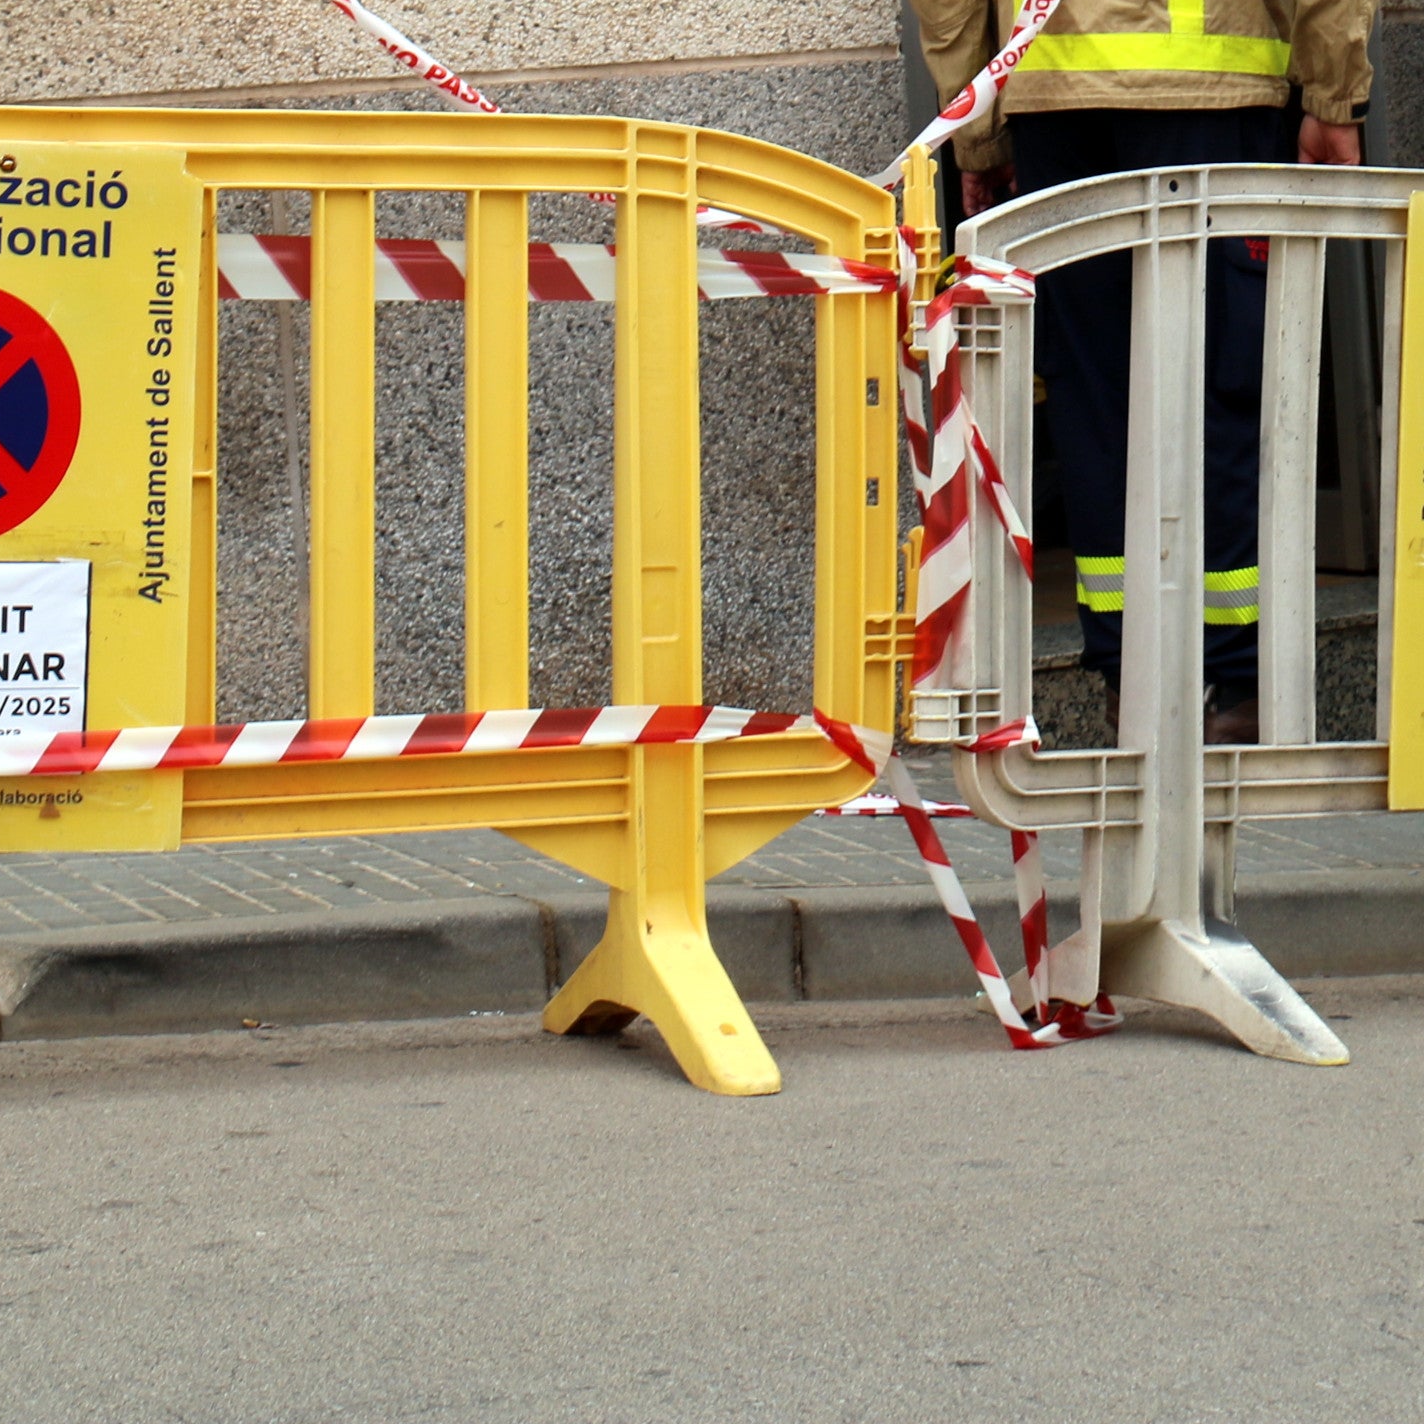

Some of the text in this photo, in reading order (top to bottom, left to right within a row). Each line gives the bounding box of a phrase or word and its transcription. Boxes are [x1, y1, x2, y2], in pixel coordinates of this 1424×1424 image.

[139, 247, 177, 604] Ajuntament de Sallent
